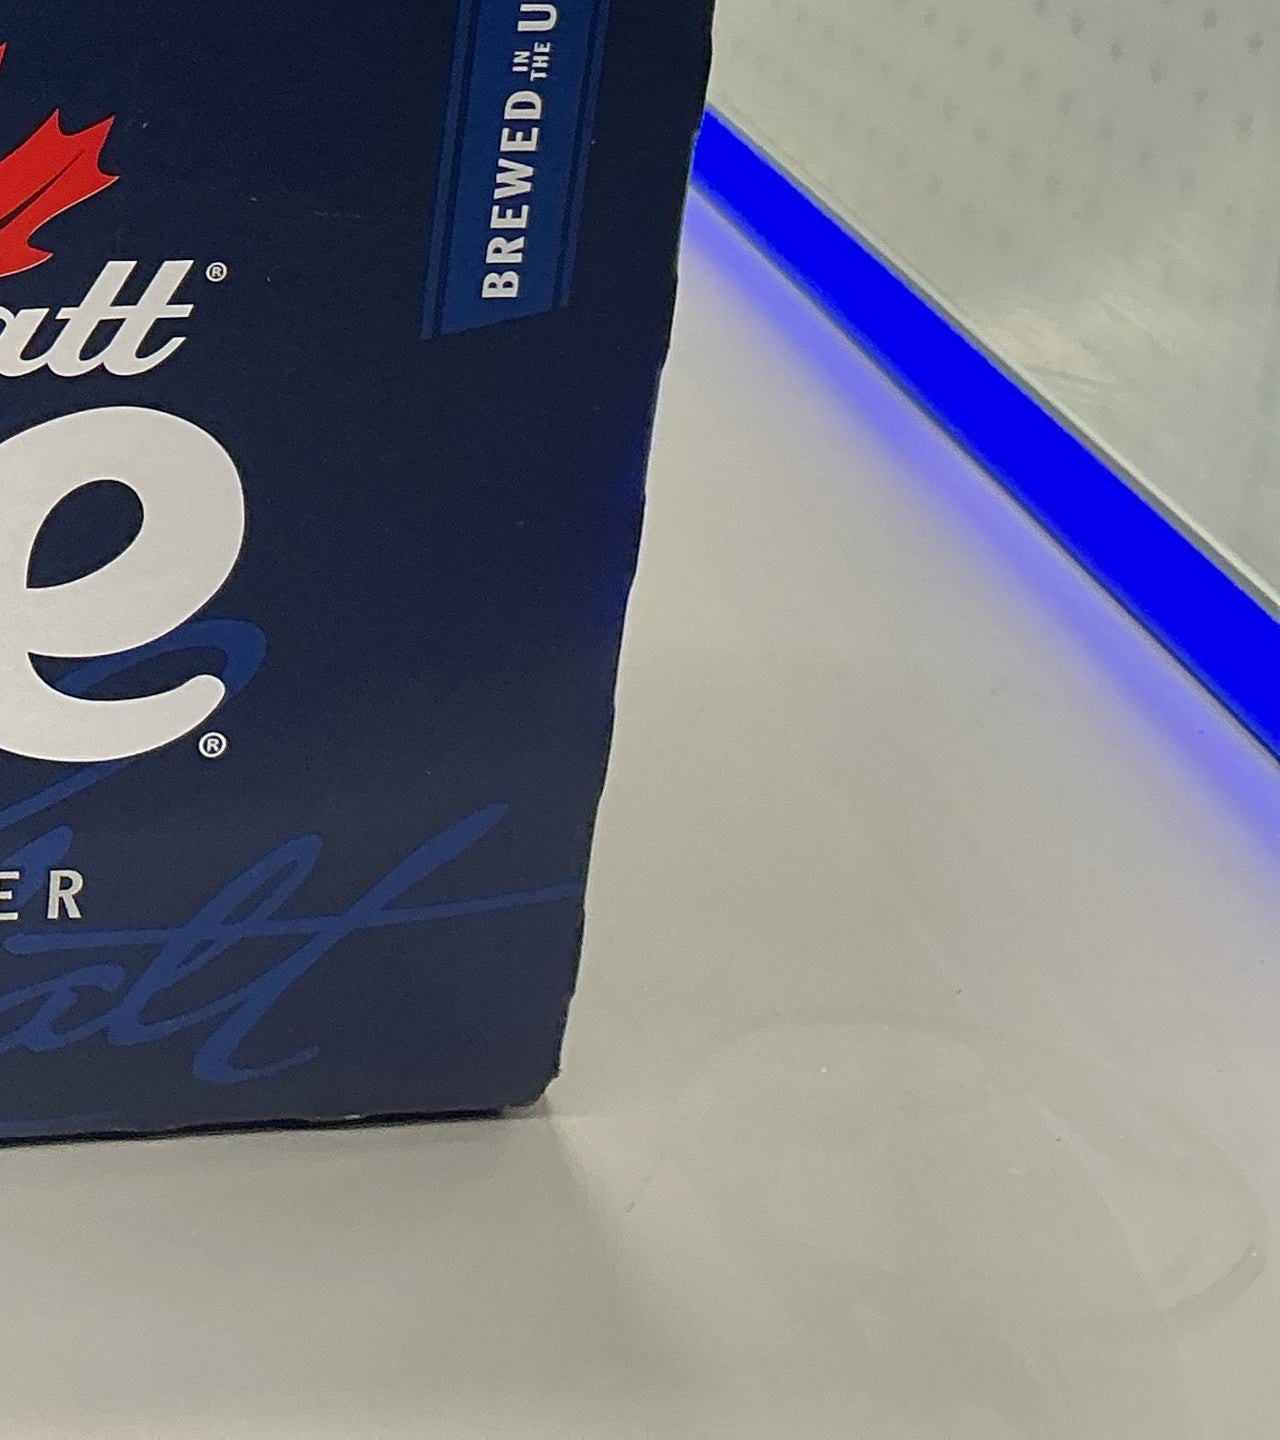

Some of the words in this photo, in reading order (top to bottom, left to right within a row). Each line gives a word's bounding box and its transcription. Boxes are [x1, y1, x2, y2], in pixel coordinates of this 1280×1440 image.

[481, 90, 543, 299] BREWED
[512, 51, 530, 72] IN
[530, 41, 550, 82] THE
